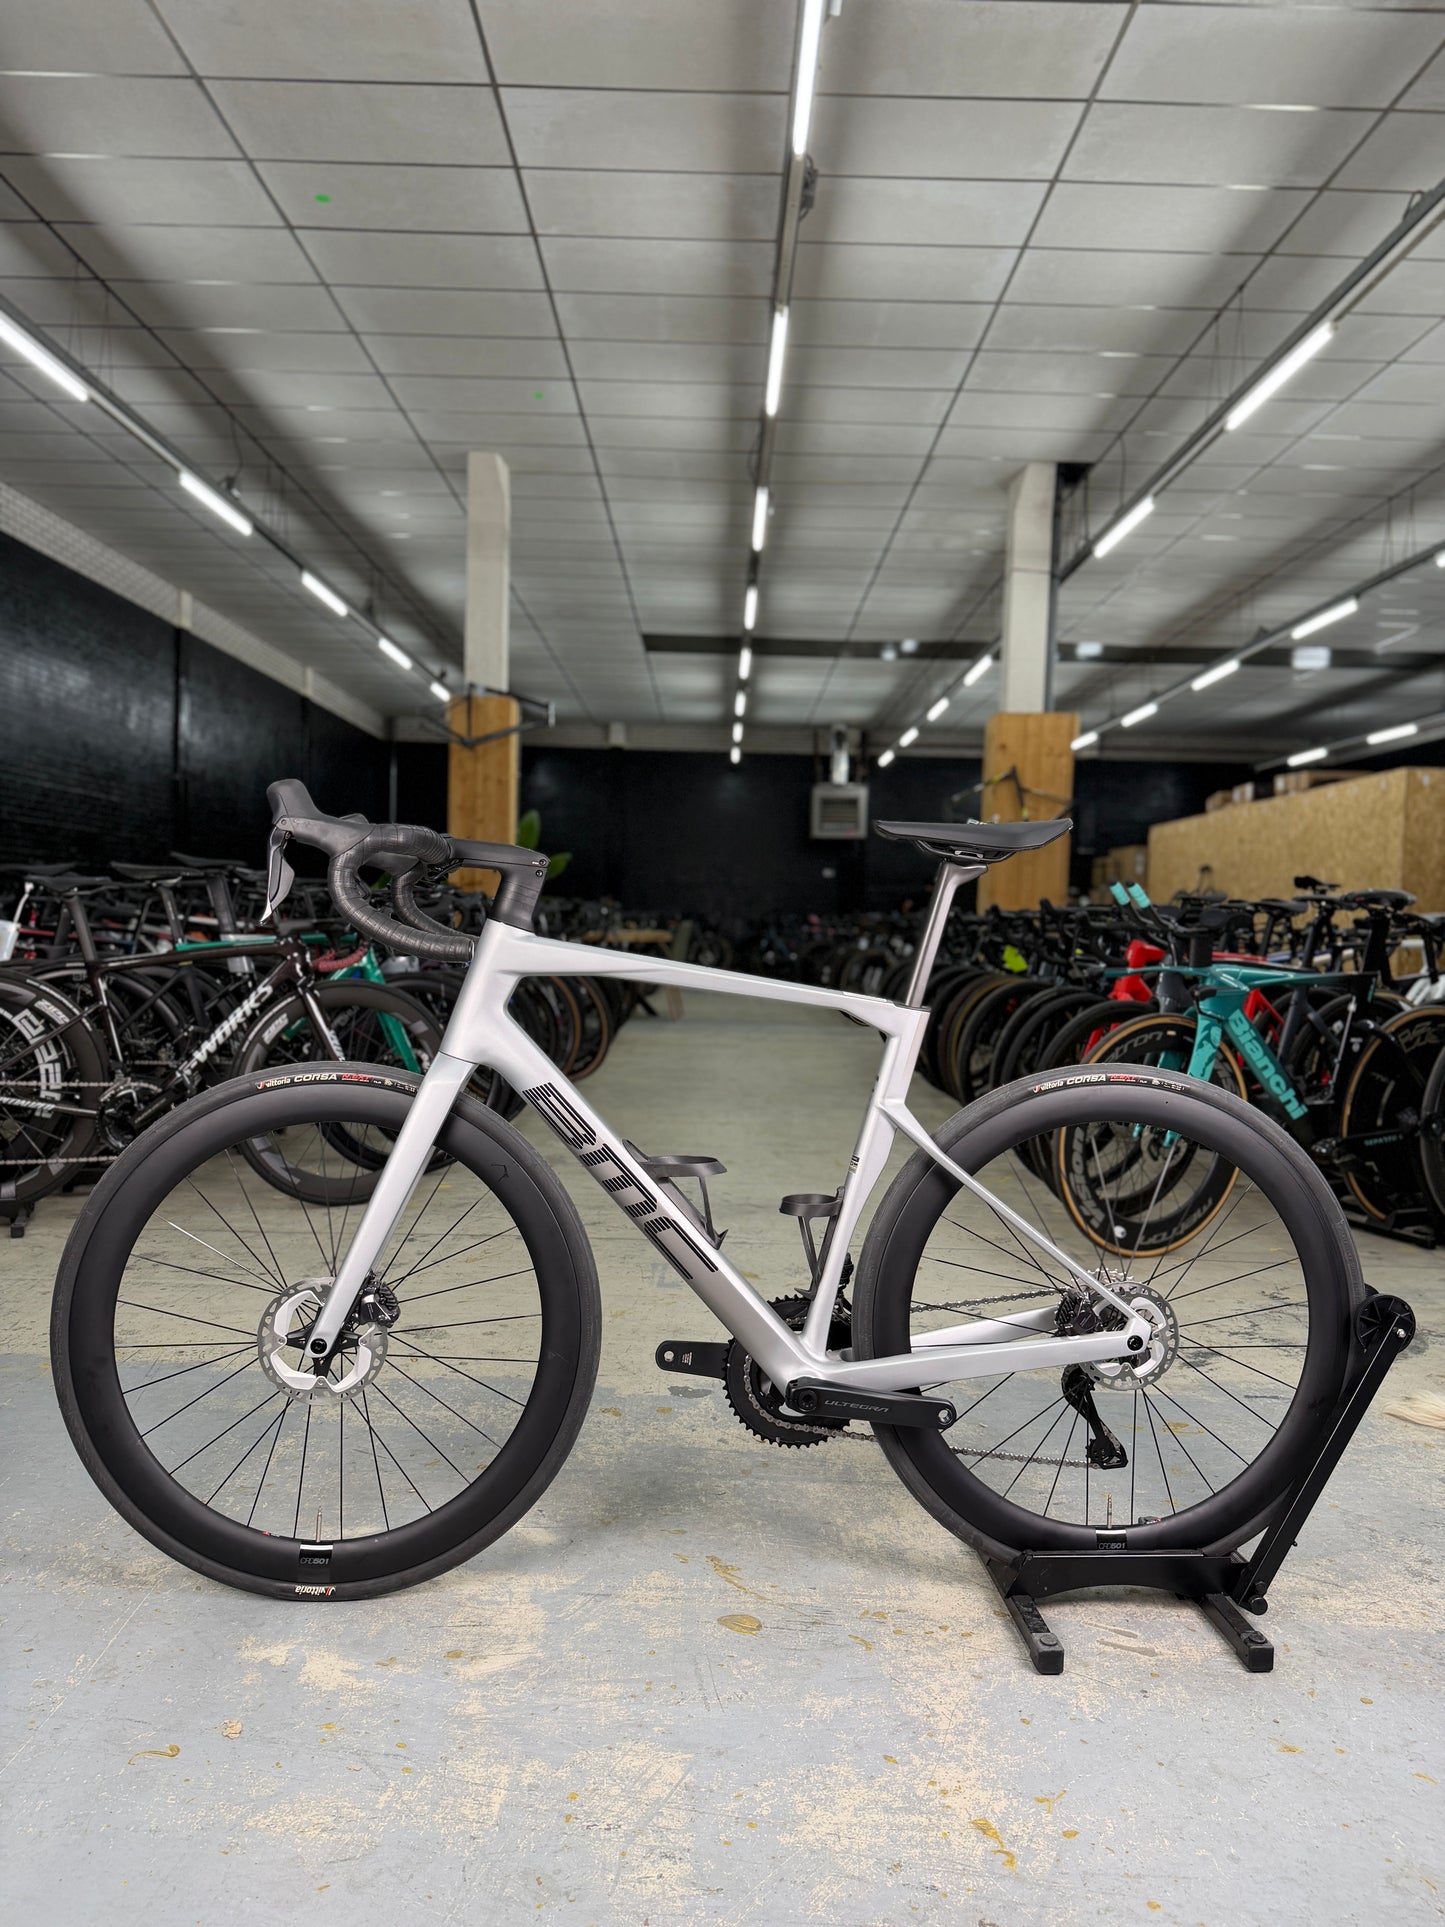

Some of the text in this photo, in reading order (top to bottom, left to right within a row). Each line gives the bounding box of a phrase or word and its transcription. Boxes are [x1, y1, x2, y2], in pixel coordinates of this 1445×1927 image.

[1228, 1009, 1308, 1120] Bianchi
[294, 1072, 338, 1083] CORSA
[1066, 1074, 1107, 1085] CORSA
[824, 1400, 889, 1413] ULTEGRA
[294, 1585, 326, 1596] vittoria
